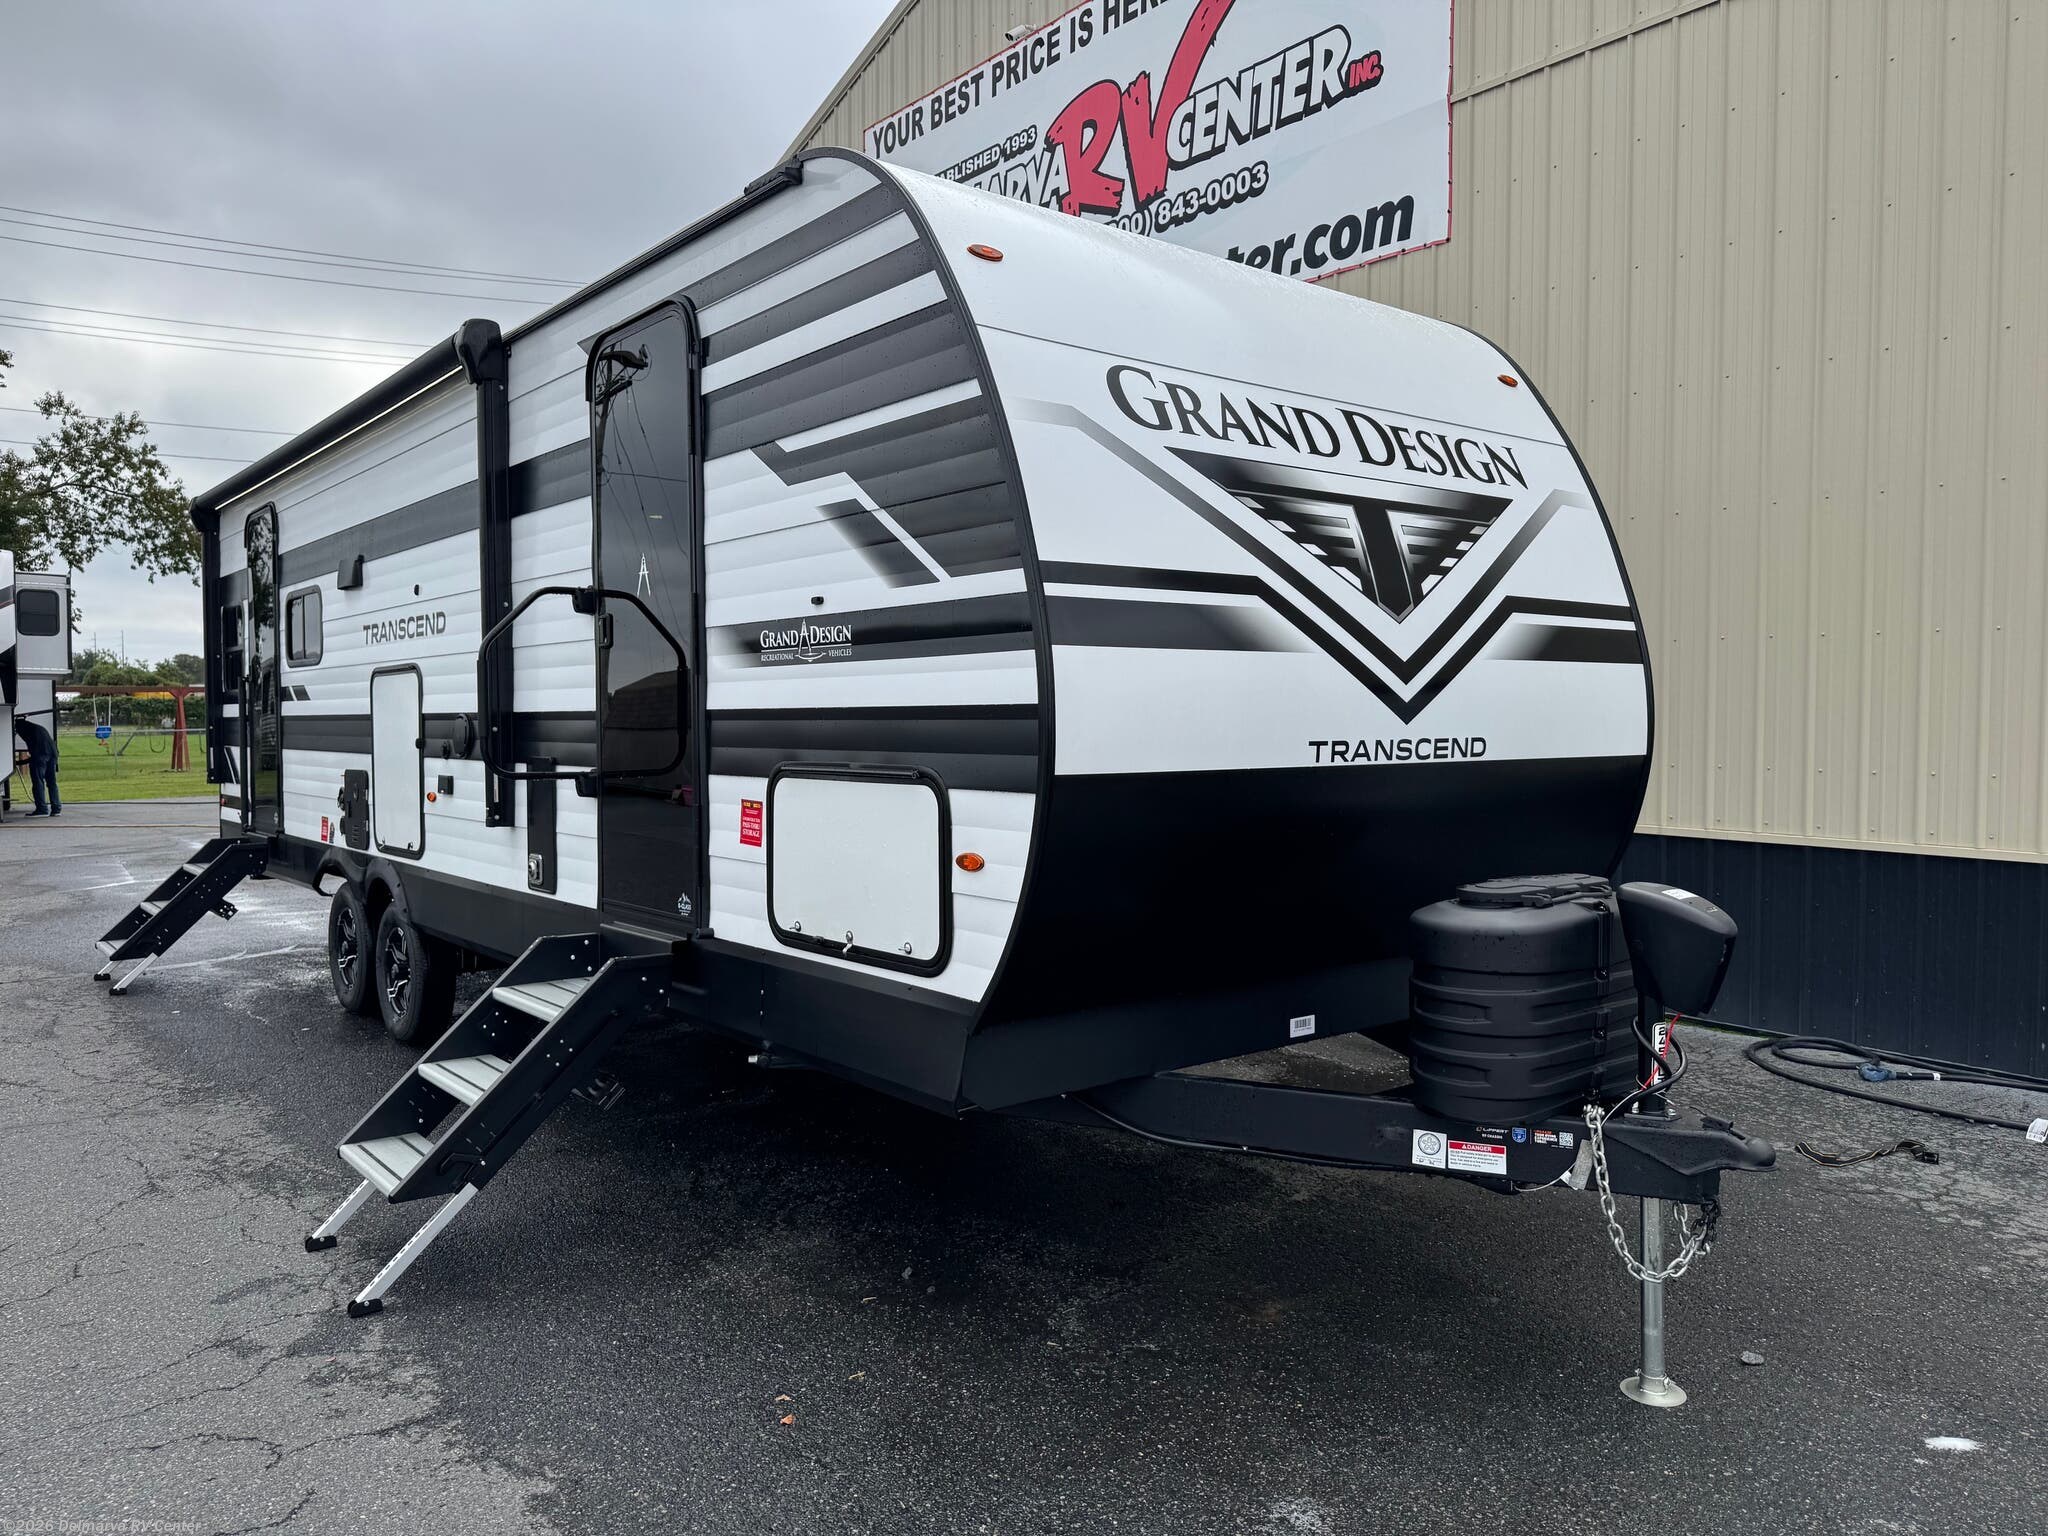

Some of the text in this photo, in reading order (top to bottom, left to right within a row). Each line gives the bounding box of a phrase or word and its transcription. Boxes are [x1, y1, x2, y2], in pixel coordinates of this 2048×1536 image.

[872, 106, 924, 159] YOUR
[931, 71, 984, 130] BEST
[991, 26, 1061, 97] PRICE
[1070, 8, 1093, 54] IS
[1046, 0, 1236, 217] RV
[1166, 25, 1351, 165] CENTER
[1004, 127, 1036, 155] 1993
[1157, 163, 1268, 228] 843-0003
[1106, 364, 1529, 489] GRAND DESIGN
[363, 611, 447, 645] TRANSCEND
[760, 625, 852, 648] GRAND DESIGN
[828, 648, 852, 657] VEHICLES
[1308, 737, 1487, 763] TRANSCEND
[1466, 1144, 1492, 1152] DANGER
